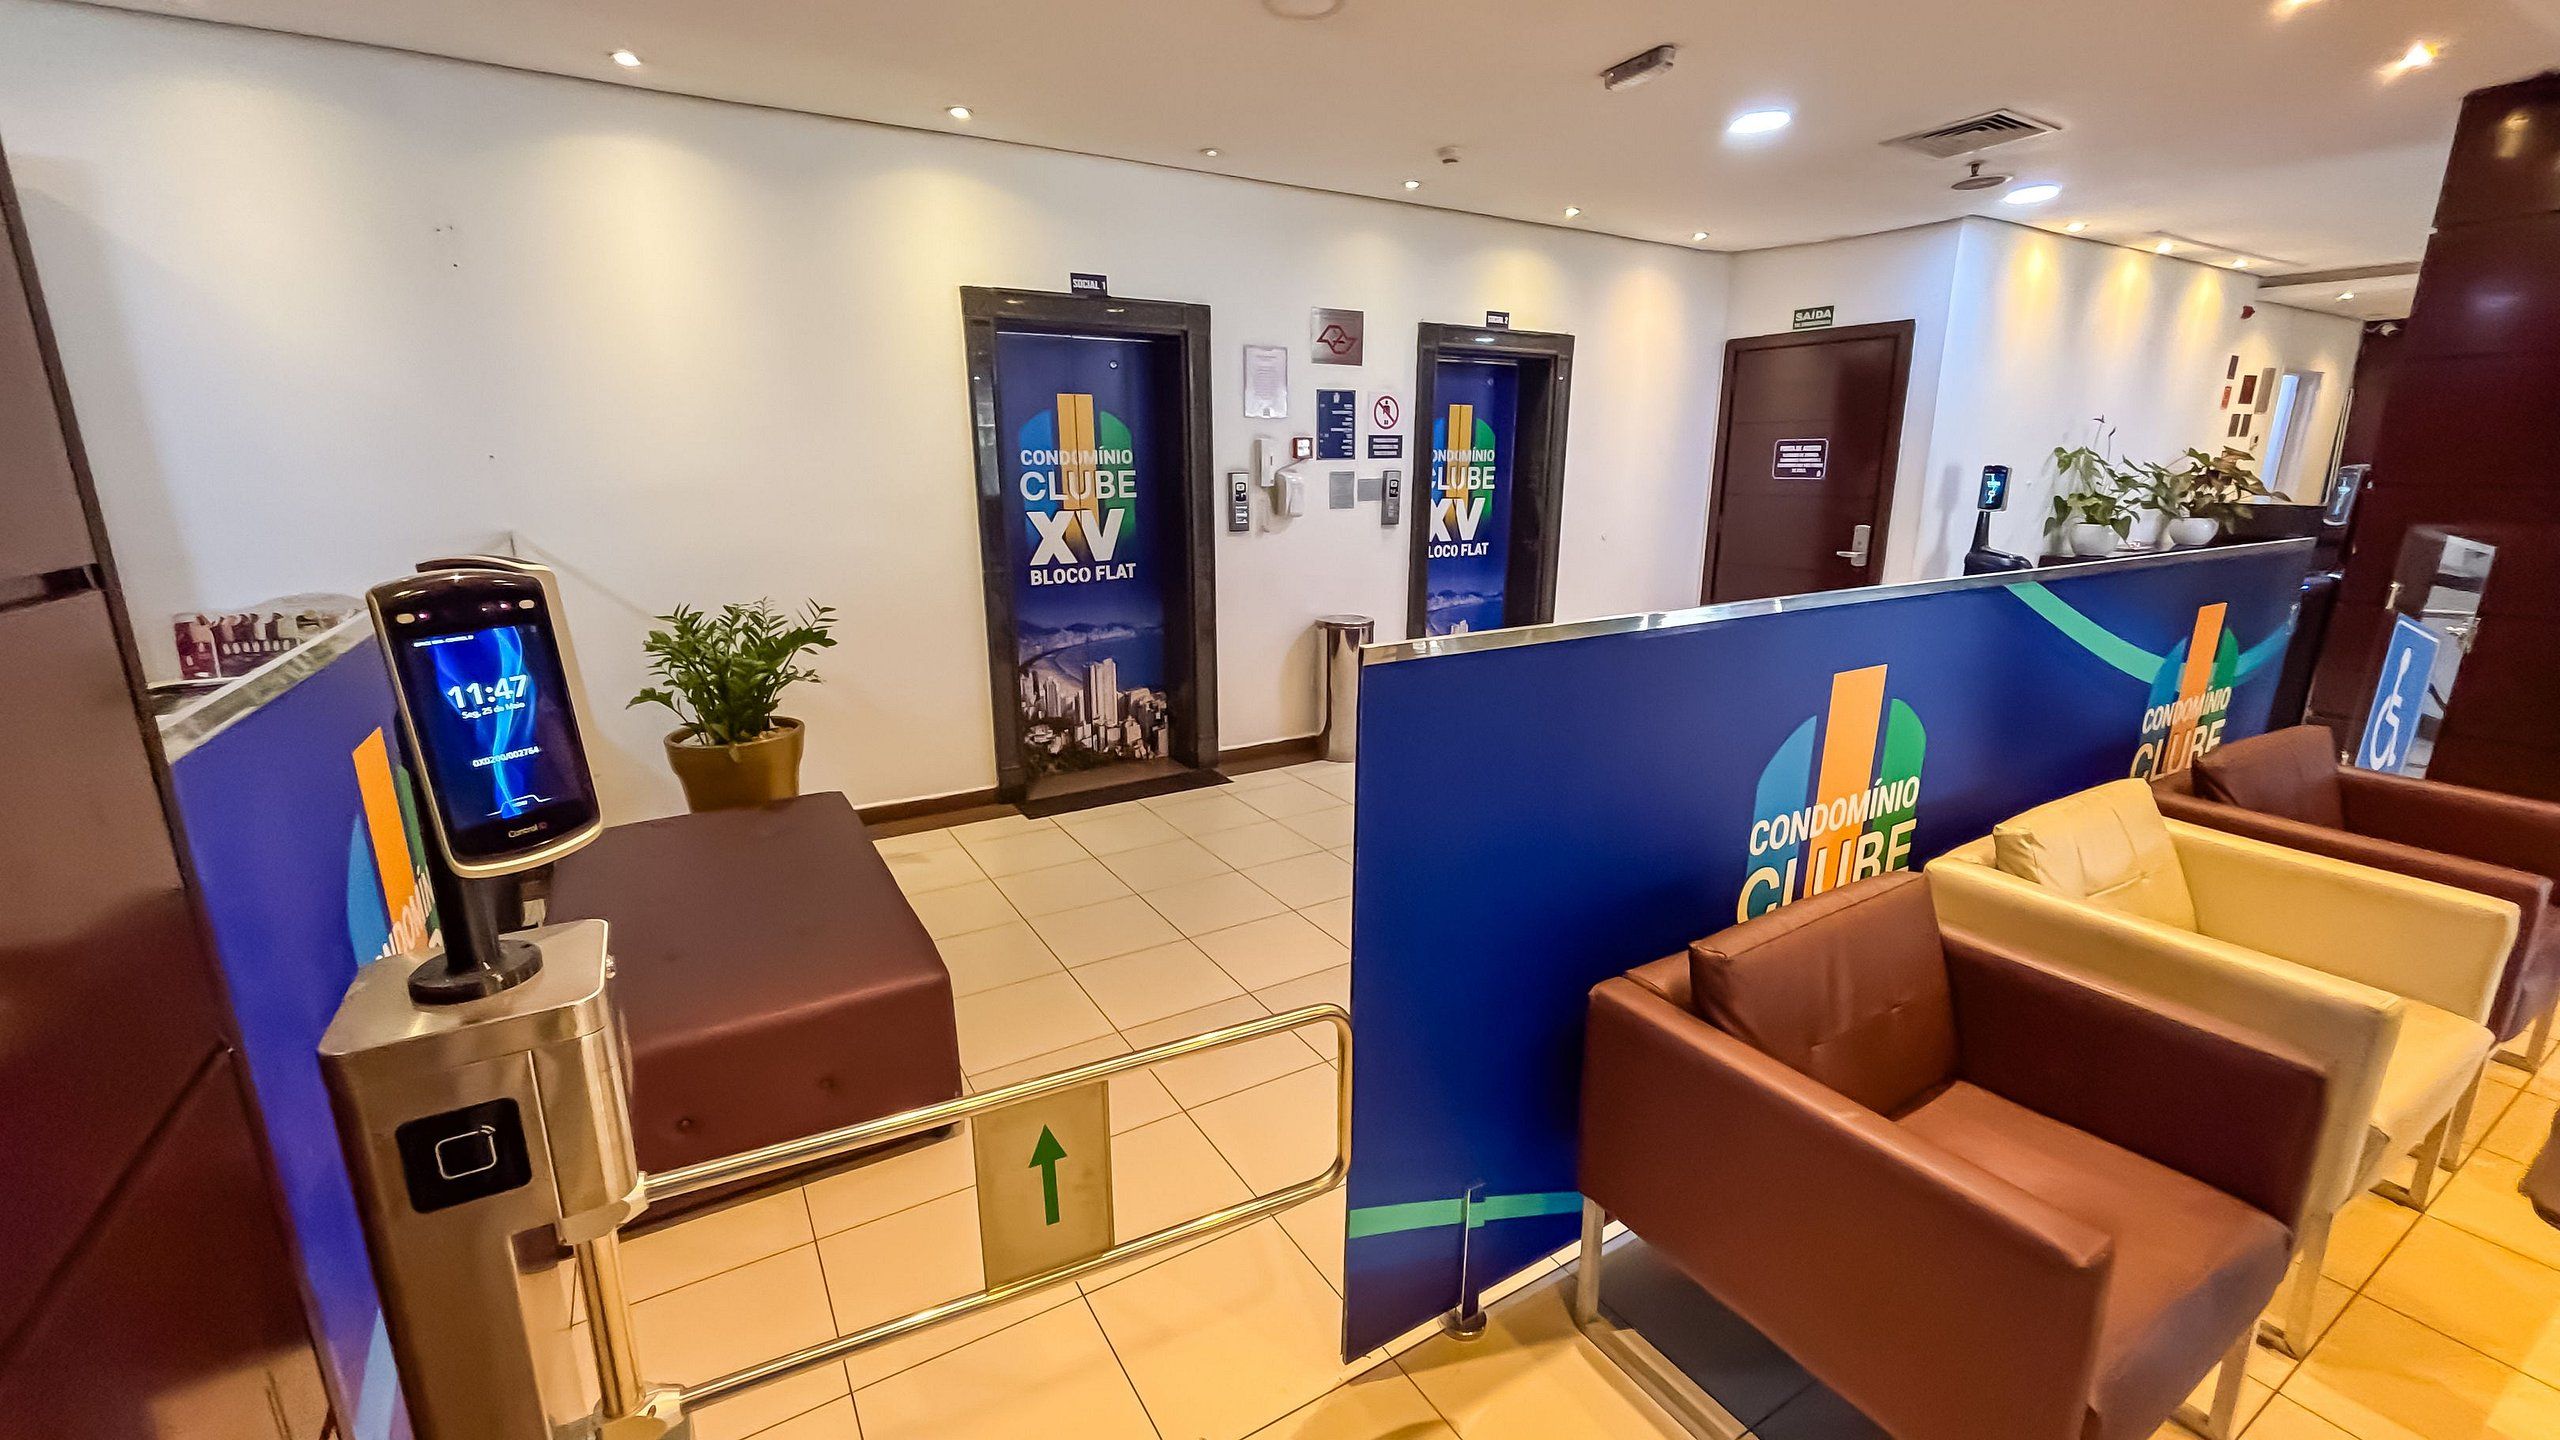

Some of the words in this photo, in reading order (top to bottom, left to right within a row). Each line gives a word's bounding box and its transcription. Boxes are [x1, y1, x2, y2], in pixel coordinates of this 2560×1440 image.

[1073, 278, 1100, 290] SOCIAL
[1102, 281, 1106, 290] 1
[1795, 309, 1832, 321] SAÍDA
[1020, 446, 1134, 466] CONDOMÍNIO
[1432, 446, 1496, 463] ONDOMÍNIO
[1020, 470, 1138, 501] CLUBE
[1027, 508, 1126, 566] XV
[1428, 545, 1459, 558] LOCO
[1460, 542, 1490, 556] FLAT
[1030, 567, 1092, 586] BLOCO
[1095, 563, 1137, 582] FLAT
[447, 674, 528, 709] 11:47
[481, 706, 493, 716] 25
[493, 704, 505, 713] de
[505, 701, 526, 710] Maio
[2142, 685, 2232, 735] CONDOMÍNIO
[1749, 776, 1921, 857] CONDOMÍNIO
